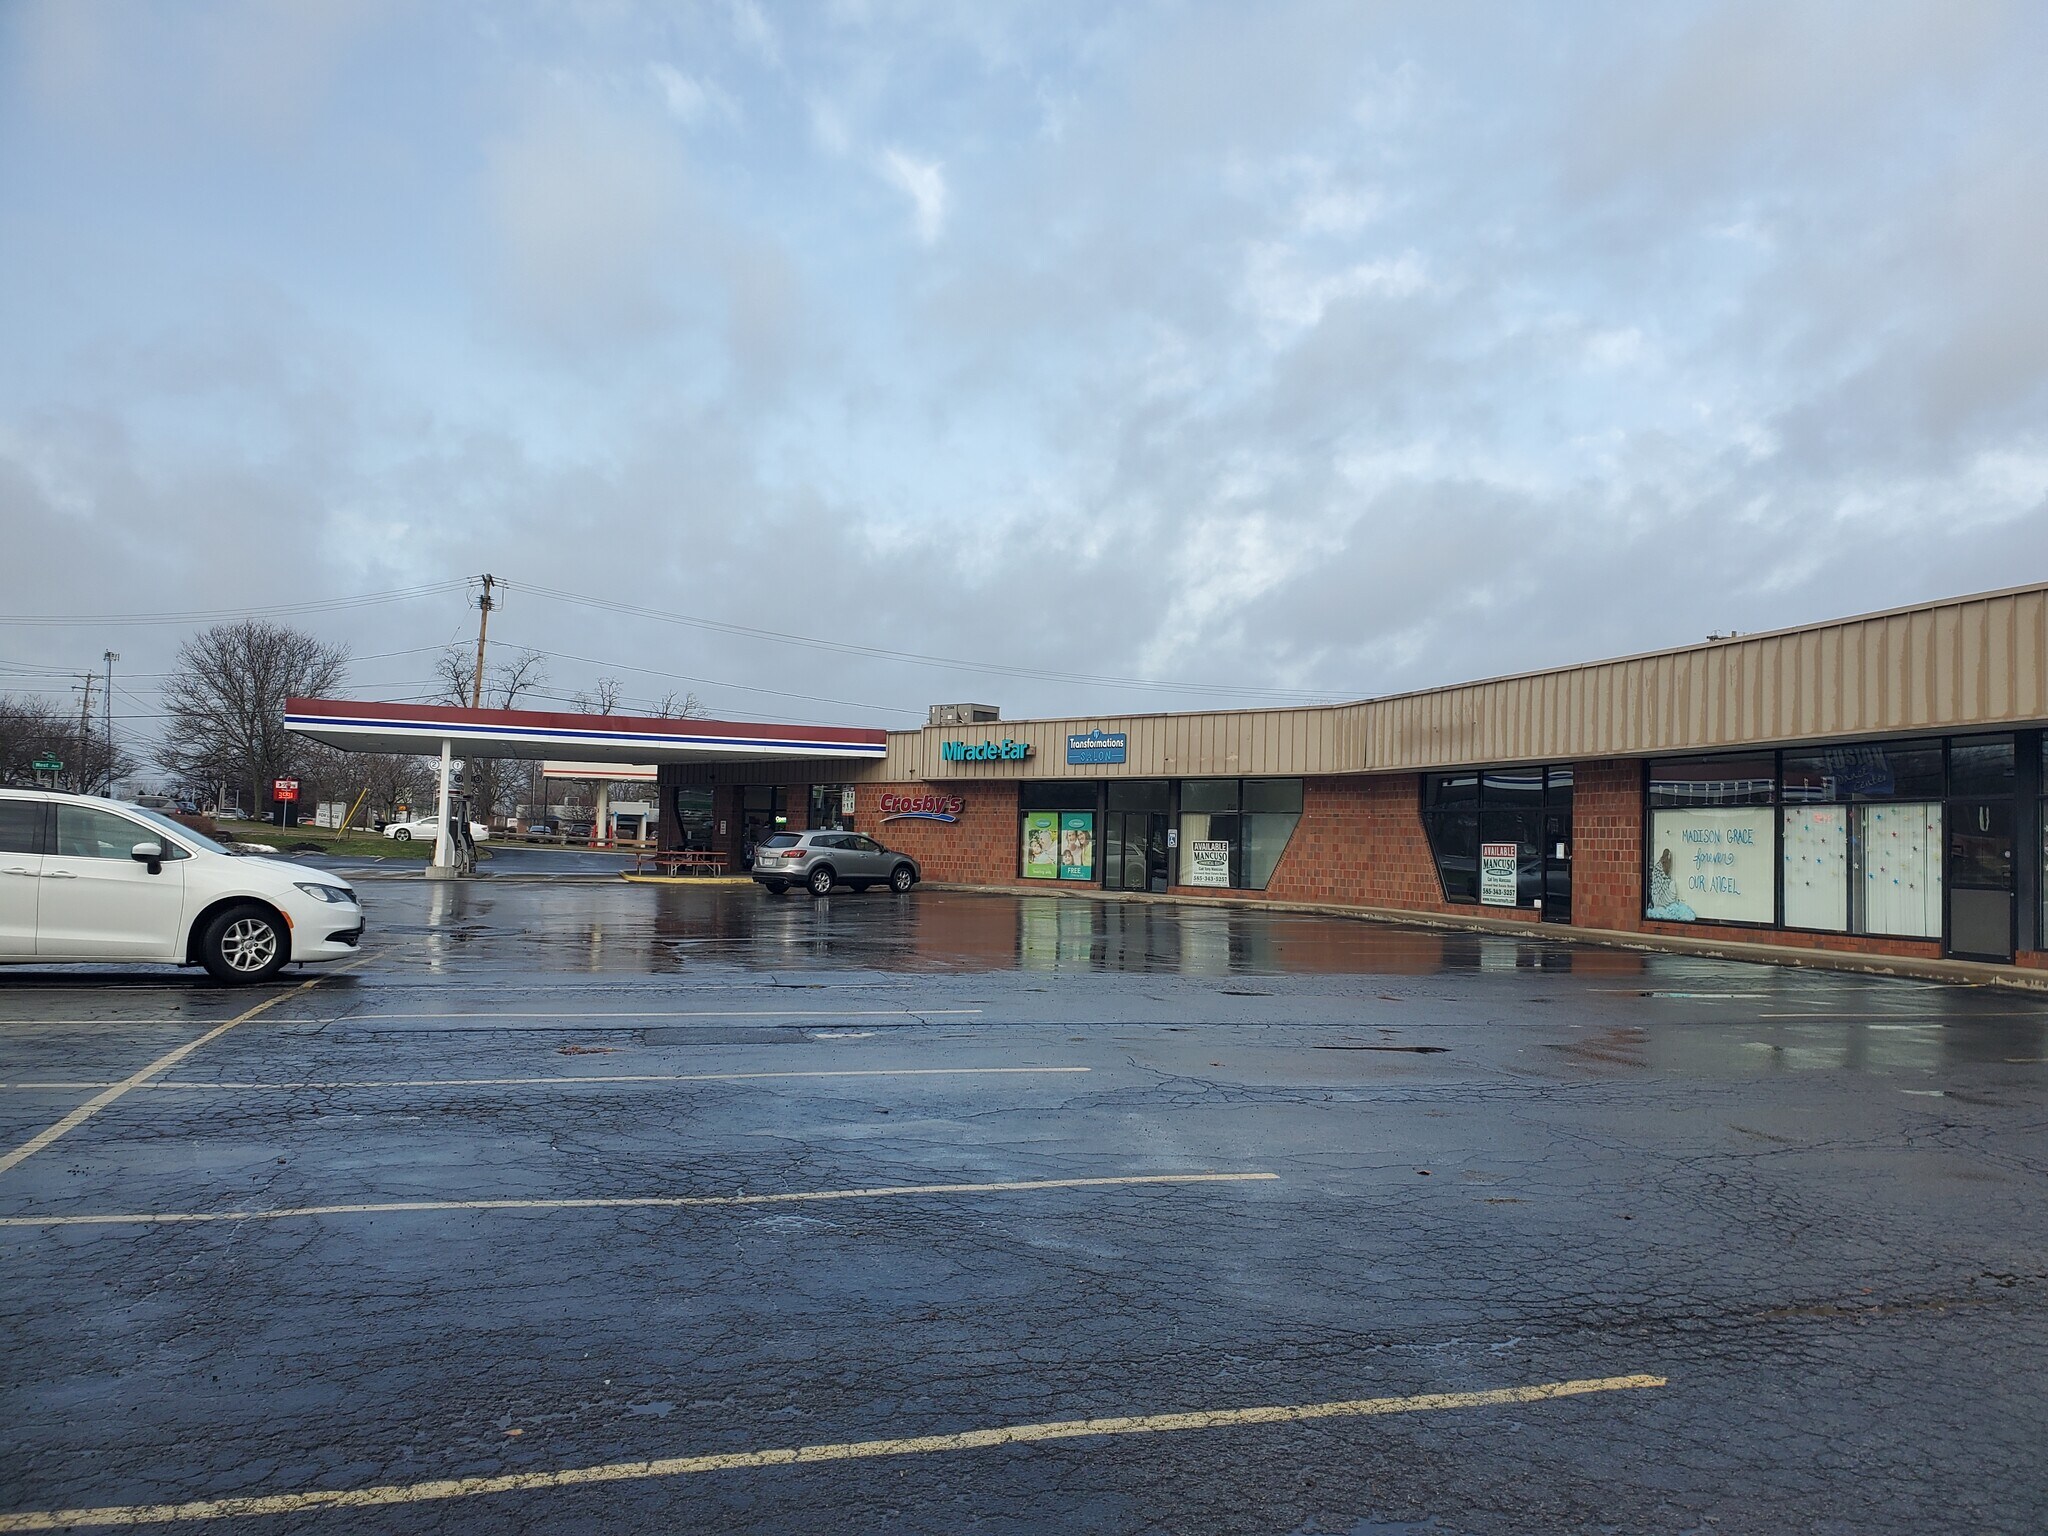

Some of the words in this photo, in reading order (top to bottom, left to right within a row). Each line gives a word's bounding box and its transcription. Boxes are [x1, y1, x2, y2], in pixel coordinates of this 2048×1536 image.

[942, 739, 1029, 761] Miracle-Ear
[1070, 738, 1124, 748] Transformations
[1080, 751, 1111, 762] SALON
[1824, 747, 1888, 774] FUSION
[880, 793, 964, 814] Crosby's
[1682, 829, 1721, 844] MADISON
[1726, 828, 1754, 844] GRACE
[1194, 842, 1227, 850] AVAILABLE
[1484, 846, 1515, 857] AVAILABLE
[1194, 852, 1228, 862] MANCUSO
[1482, 858, 1516, 870] MANCUSO
[1692, 848, 1735, 870] forever
[1688, 874, 1706, 892] OUR
[1710, 876, 1740, 895] ANGEL
